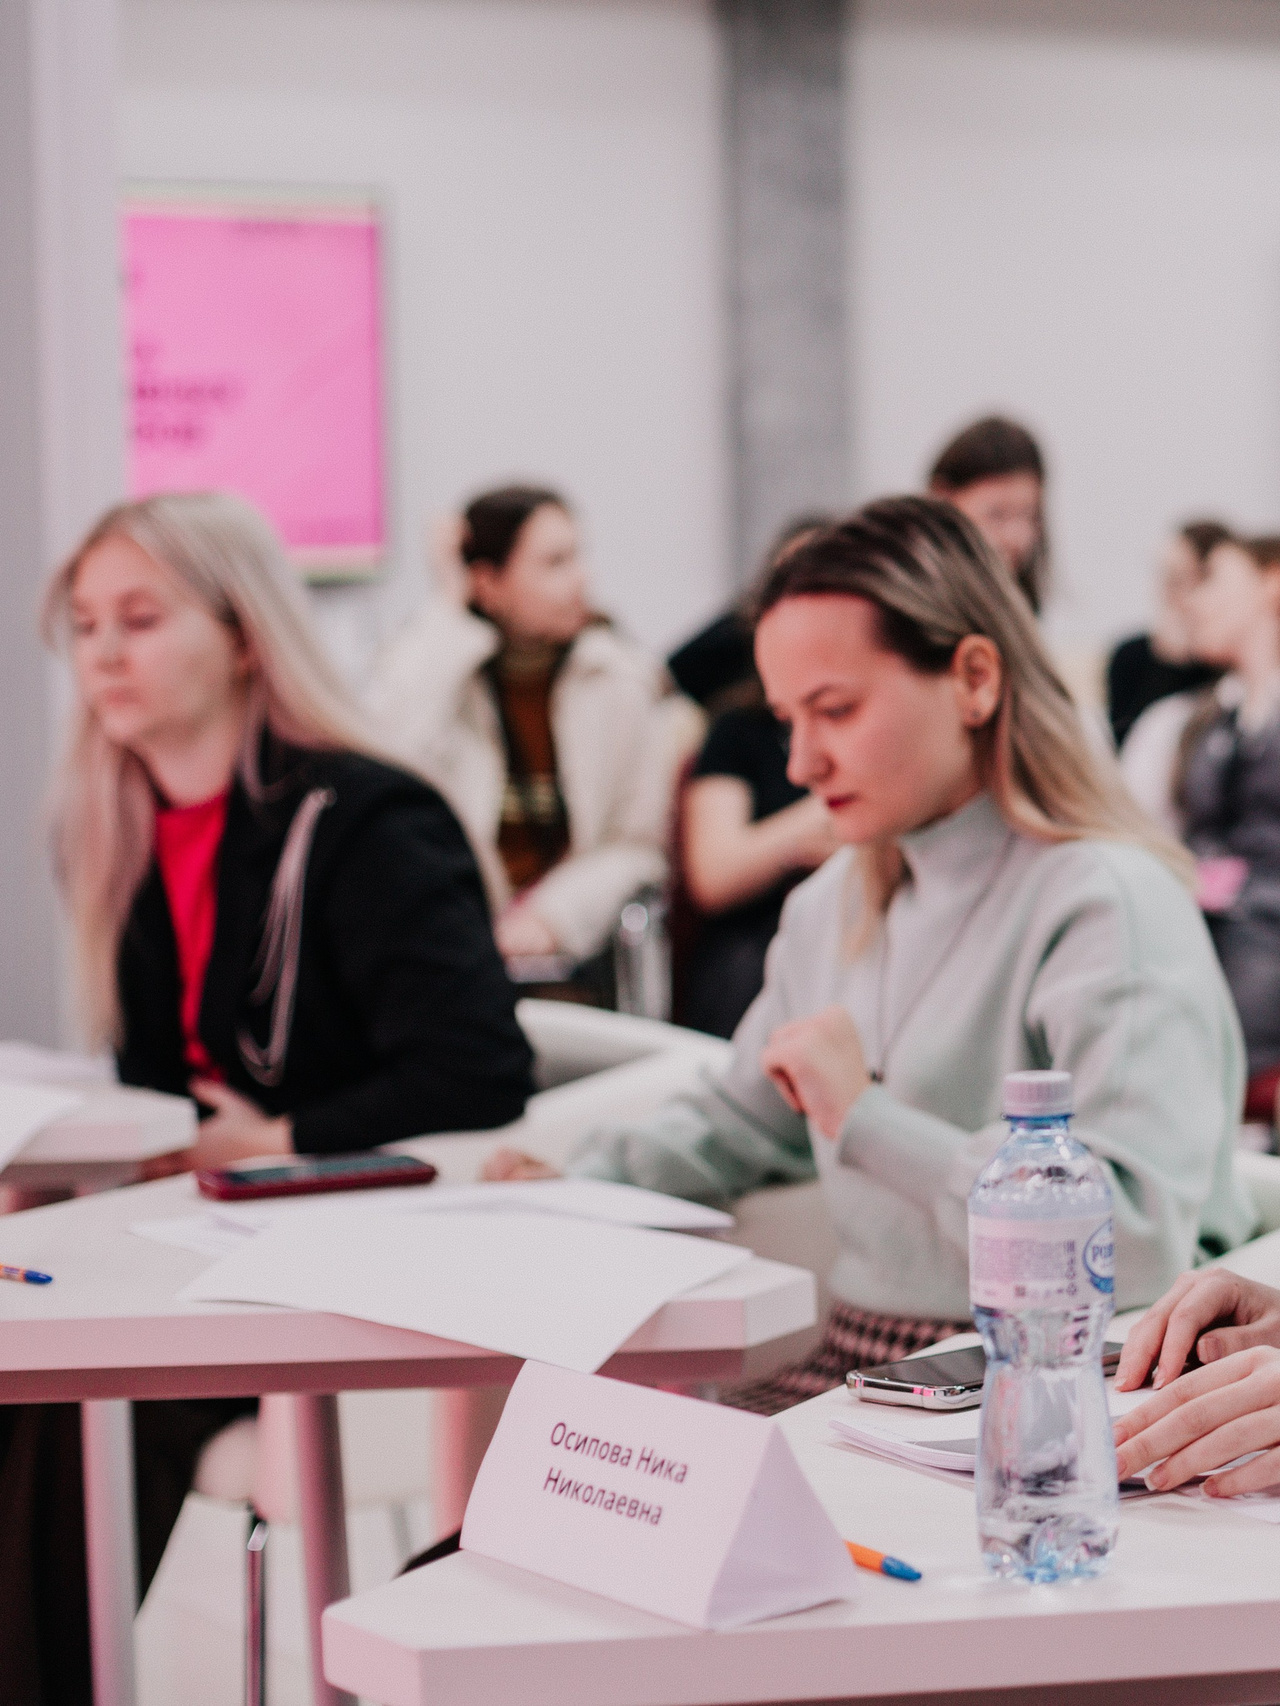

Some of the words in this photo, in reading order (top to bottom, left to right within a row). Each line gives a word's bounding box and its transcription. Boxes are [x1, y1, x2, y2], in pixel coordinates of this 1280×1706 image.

[550, 1422, 633, 1467] Осипова
[638, 1447, 688, 1483] Ника
[544, 1468, 662, 1525] Николаевна
